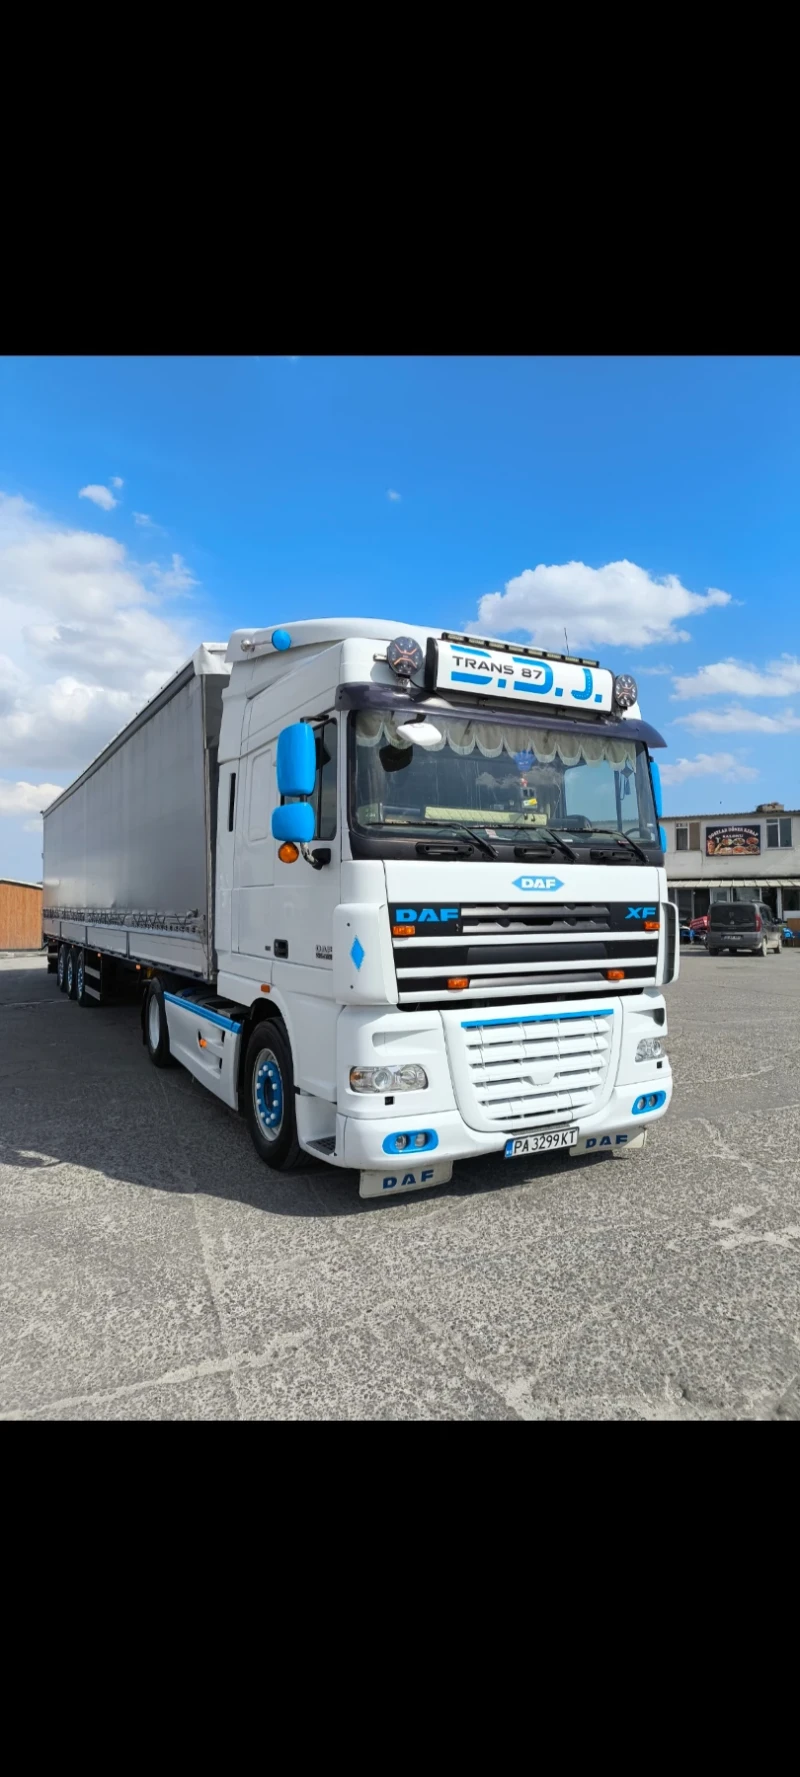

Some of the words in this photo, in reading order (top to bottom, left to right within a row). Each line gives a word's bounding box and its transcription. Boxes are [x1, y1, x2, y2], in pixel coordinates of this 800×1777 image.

[452, 655, 515, 676] TRANS
[521, 668, 543, 680] 87
[521, 877, 556, 889] DAF
[395, 908, 459, 923] DAF
[624, 907, 656, 919] XF
[514, 1139, 529, 1154] PA
[531, 1133, 560, 1151] 3299
[561, 1130, 577, 1146] KT
[585, 1134, 629, 1149] DAF
[382, 1169, 435, 1190] DAF
